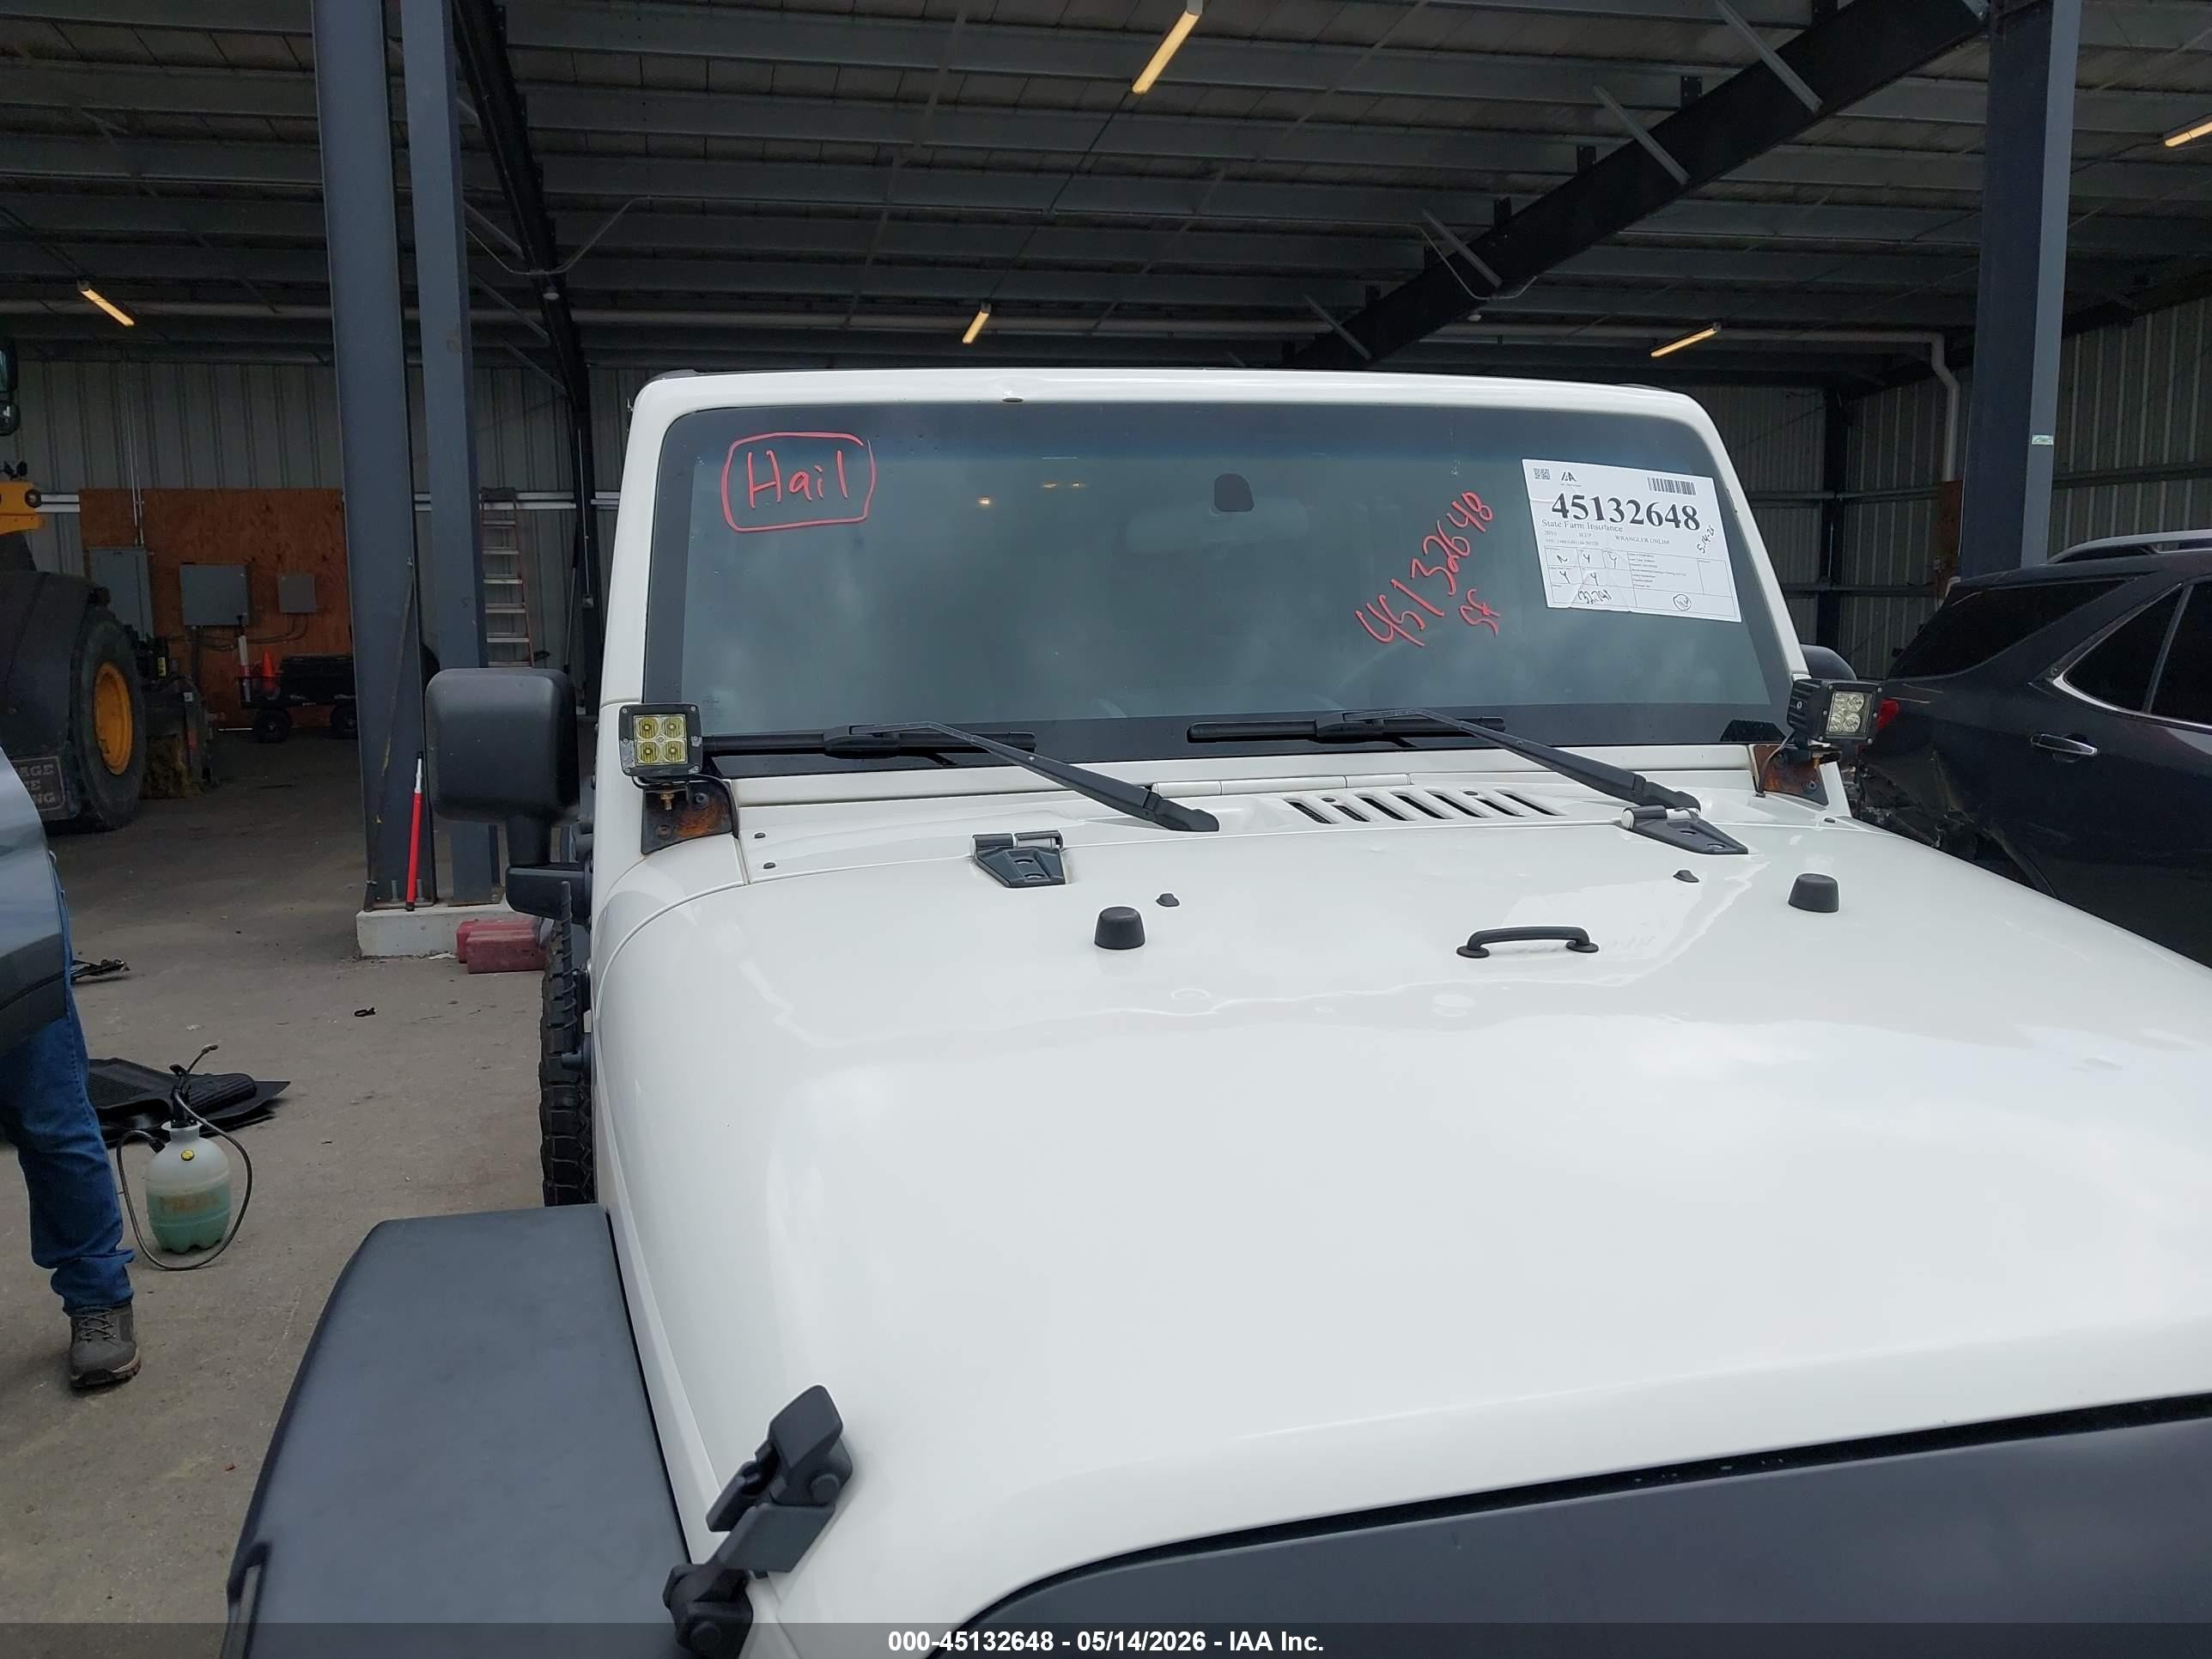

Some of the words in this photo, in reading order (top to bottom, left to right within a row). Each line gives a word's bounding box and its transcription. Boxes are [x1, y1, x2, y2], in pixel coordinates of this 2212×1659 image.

[747, 449, 848, 509] Hail
[1552, 493, 1700, 531] 45132648
[1564, 521, 1585, 530] Farm
[1587, 522, 1623, 532] Insurance
[1355, 491, 1493, 647] 45132648
